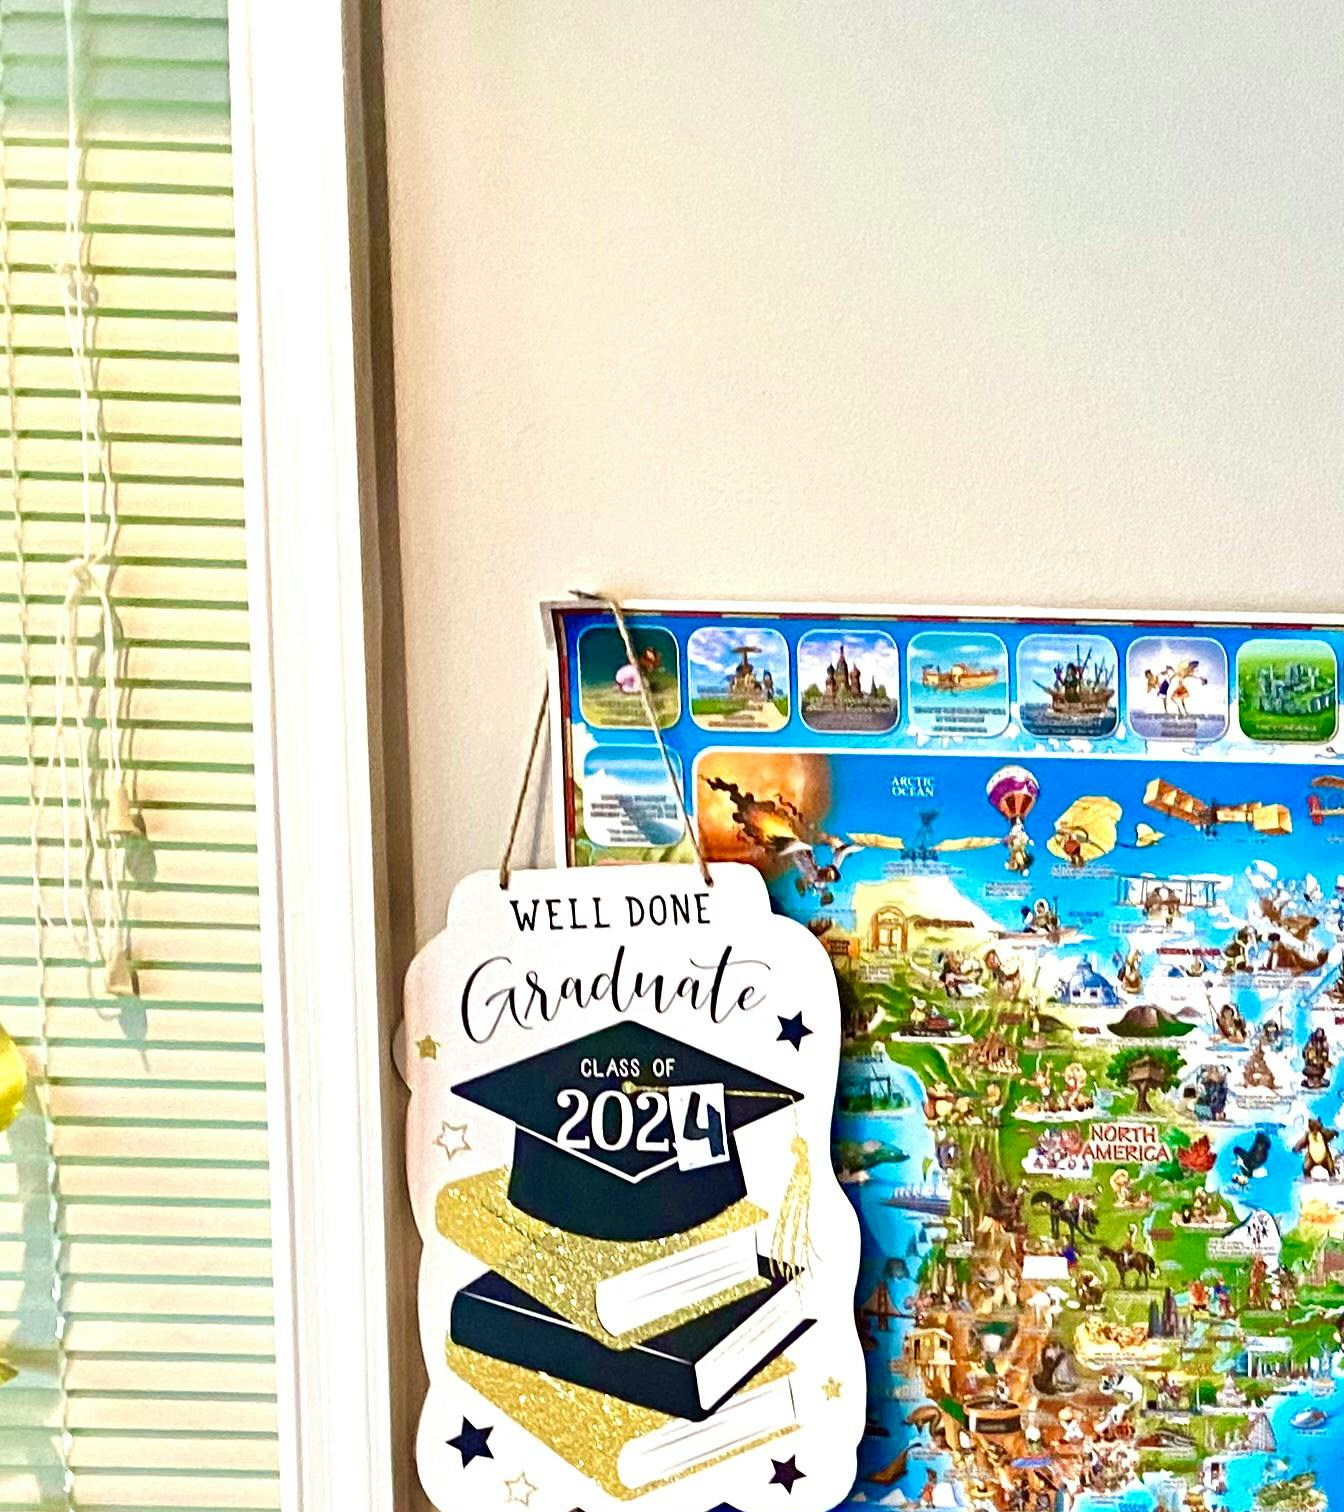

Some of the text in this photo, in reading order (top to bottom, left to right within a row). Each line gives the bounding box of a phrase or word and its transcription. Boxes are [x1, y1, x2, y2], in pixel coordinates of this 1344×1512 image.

[510, 892, 712, 931] WELL DONE
[461, 944, 771, 1044] Graduate
[581, 1057, 676, 1079] CLASS OF
[1089, 1125, 1157, 1144] NORTH
[1082, 1143, 1171, 1162] AMERICA
